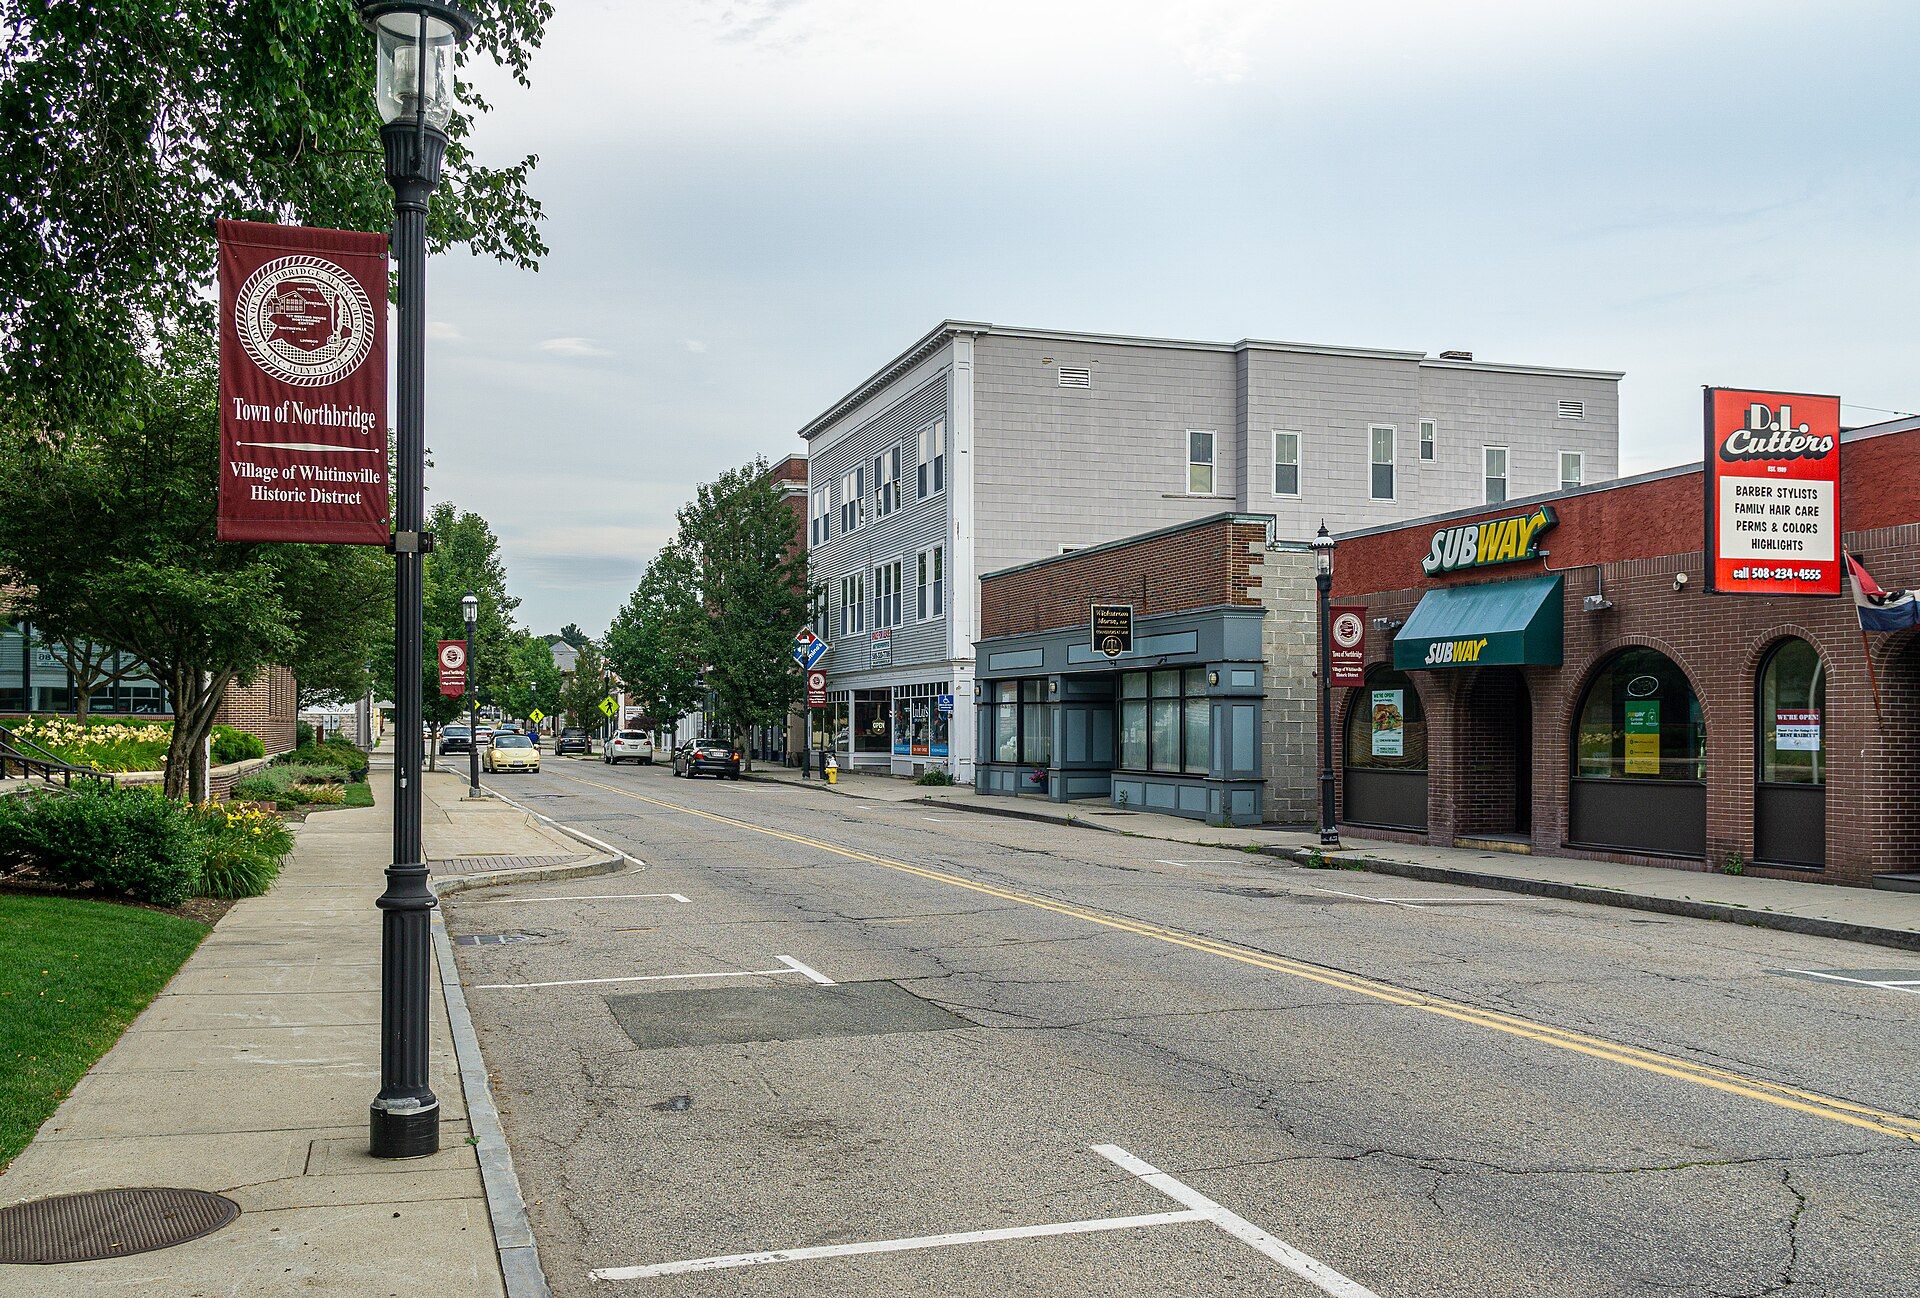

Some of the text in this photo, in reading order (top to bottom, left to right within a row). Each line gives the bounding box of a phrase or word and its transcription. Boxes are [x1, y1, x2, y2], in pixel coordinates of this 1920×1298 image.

[250, 300, 258, 314] OF
[326, 275, 361, 352] MASSACHUSETTS
[250, 316, 263, 344] TOWN
[287, 365, 311, 374] JULY
[233, 397, 376, 435] Town of Northbridge
[1750, 404, 1809, 433] D.L.
[1726, 429, 1834, 455] Cutters
[230, 461, 381, 484] Village of Whitinsville
[250, 485, 362, 505] Historic District
[1736, 486, 1818, 500] BARBER STYLISTS
[1734, 503, 1819, 516] FAMILY HAIR CARE
[1736, 520, 1818, 534] PERMS & COLORS
[1421, 511, 1546, 573] SUBWAY
[1752, 538, 1804, 551] HIGHLIGHTS
[1733, 567, 1749, 578] call
[1425, 638, 1488, 665] SUBWAY
